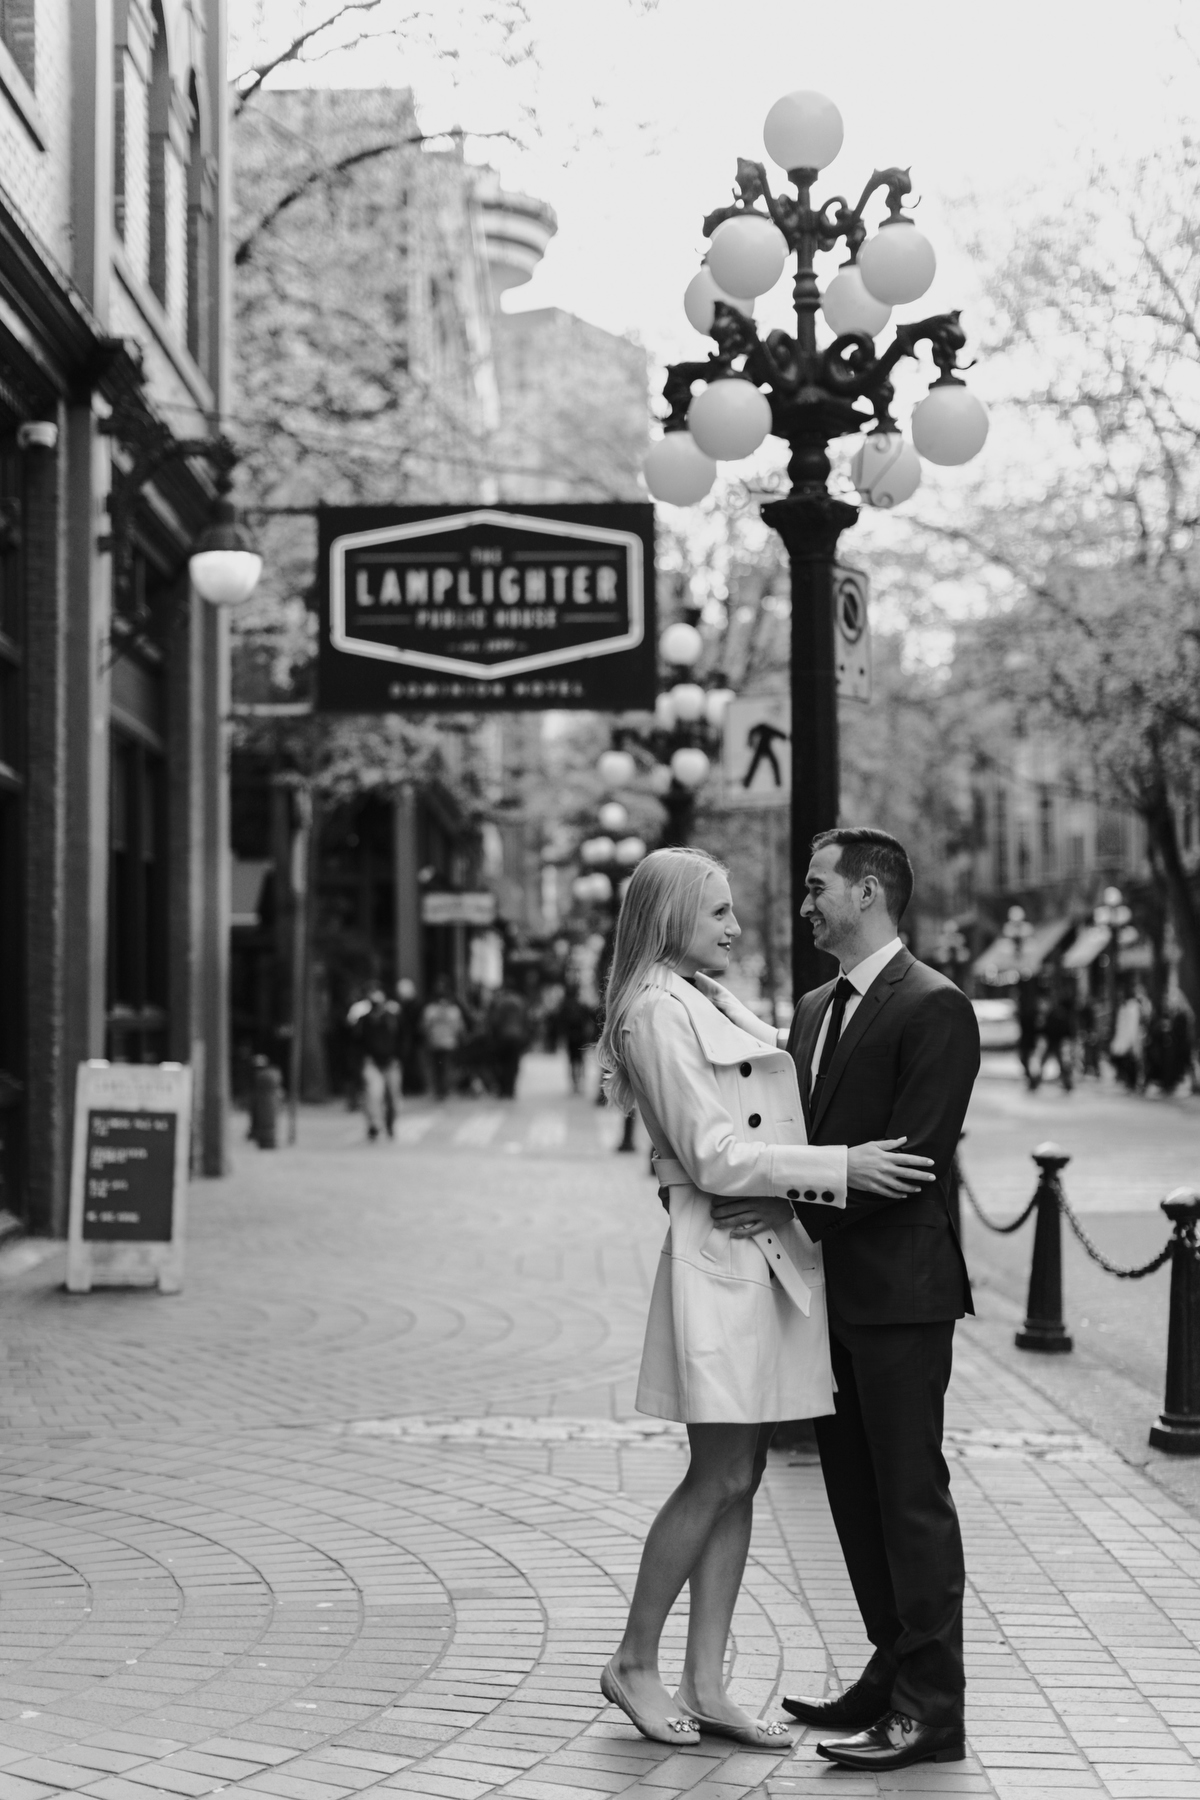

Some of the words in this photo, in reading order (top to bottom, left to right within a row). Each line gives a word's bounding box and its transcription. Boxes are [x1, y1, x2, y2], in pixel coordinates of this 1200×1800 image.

[470, 547, 502, 566] THE
[356, 566, 618, 606] LAMPLIGHTER
[415, 607, 488, 630] PUBLIC
[493, 607, 557, 629] HOUSE
